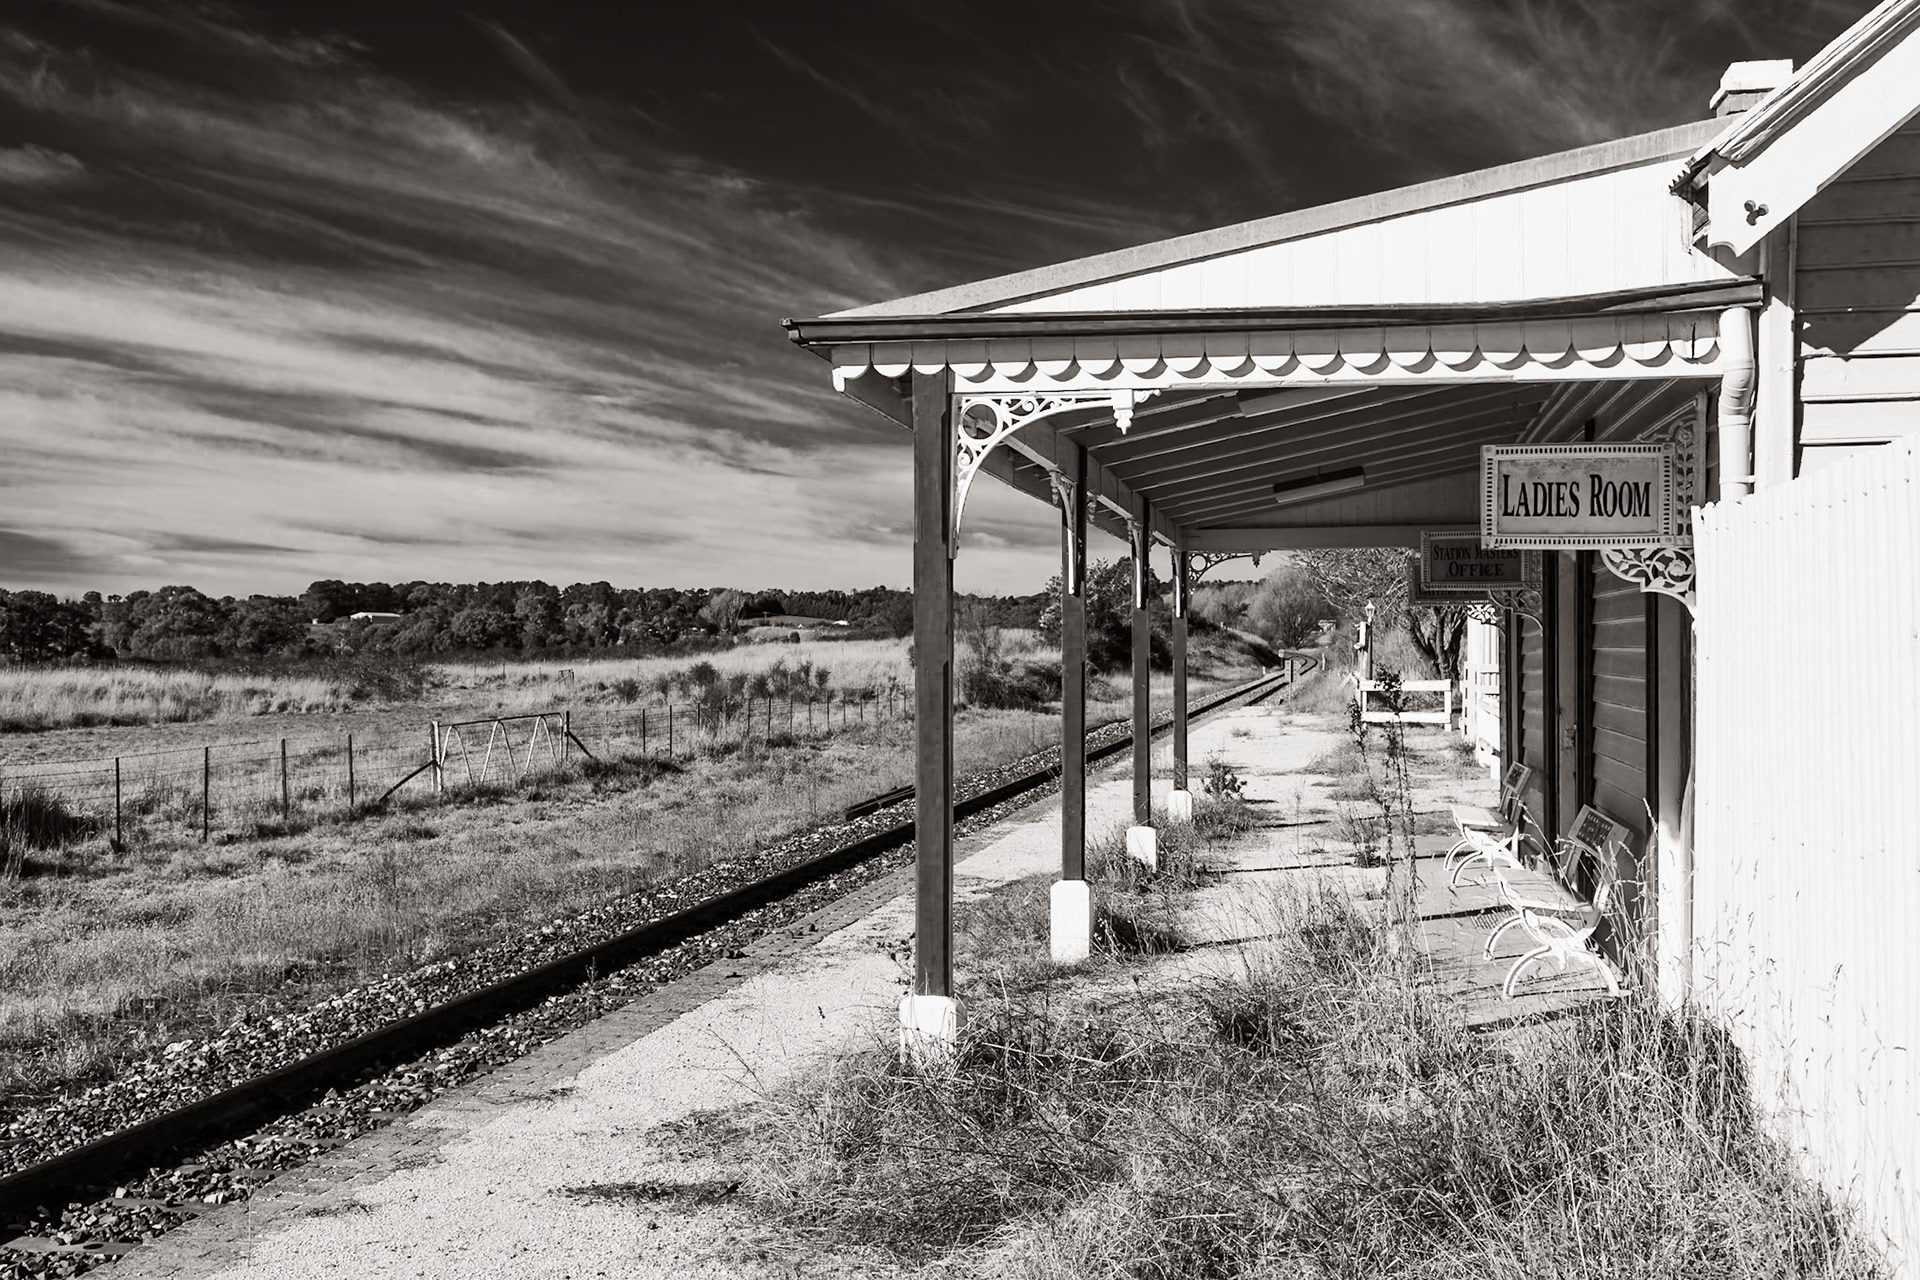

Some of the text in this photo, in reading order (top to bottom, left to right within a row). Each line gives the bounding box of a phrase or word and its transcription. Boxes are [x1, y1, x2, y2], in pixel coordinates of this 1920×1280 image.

[1502, 474, 1651, 517] LADIES ROOM
[1433, 544, 1472, 561] STATION
[1448, 560, 1504, 577] OFFICE
